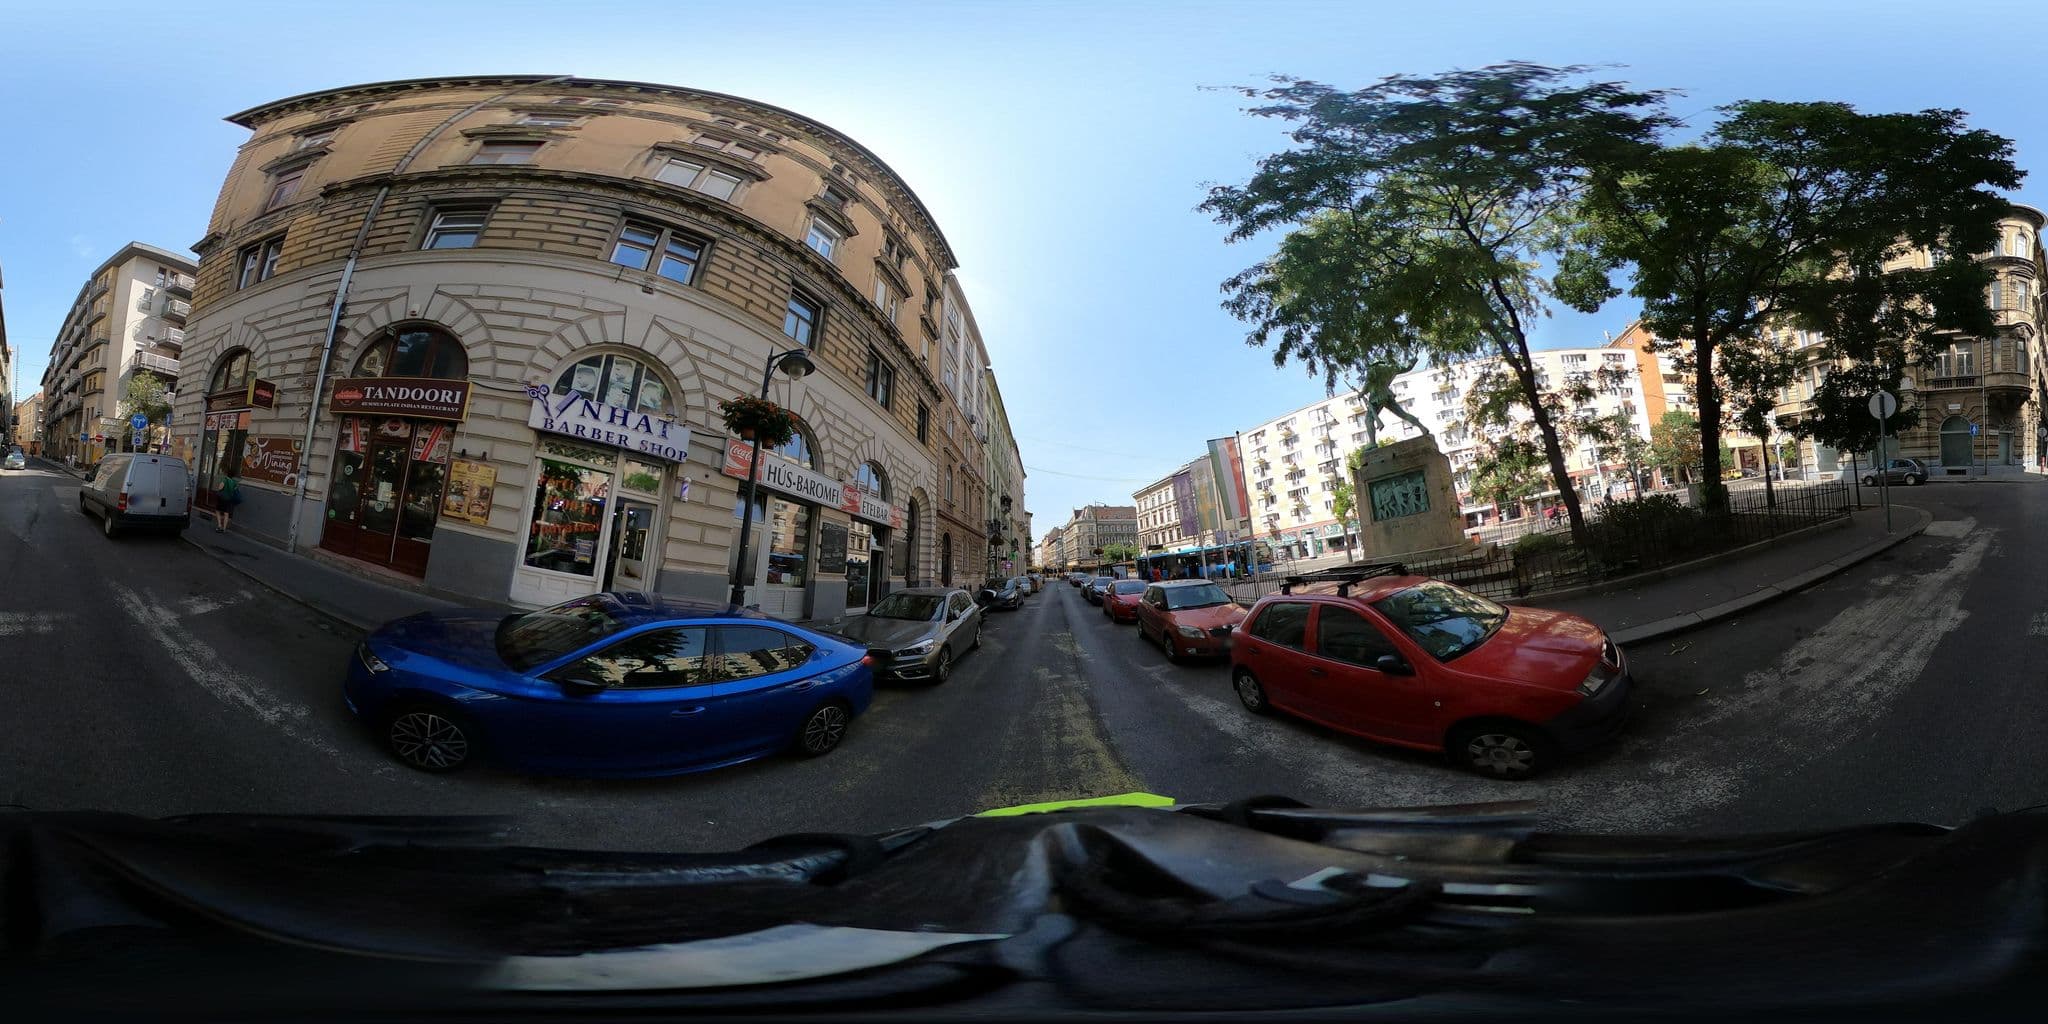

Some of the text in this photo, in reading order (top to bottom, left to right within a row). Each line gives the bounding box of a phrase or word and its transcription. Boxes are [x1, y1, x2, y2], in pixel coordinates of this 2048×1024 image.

[364, 386, 462, 404] TANDOORI
[421, 404, 459, 413] RESTAURANT
[580, 399, 673, 440] NHAT
[543, 417, 688, 462] BARBER SHOP
[263, 452, 292, 474] Dining
[767, 464, 840, 504] HÚS-BAROMFI
[862, 497, 889, 521] ÉTELBÁR
